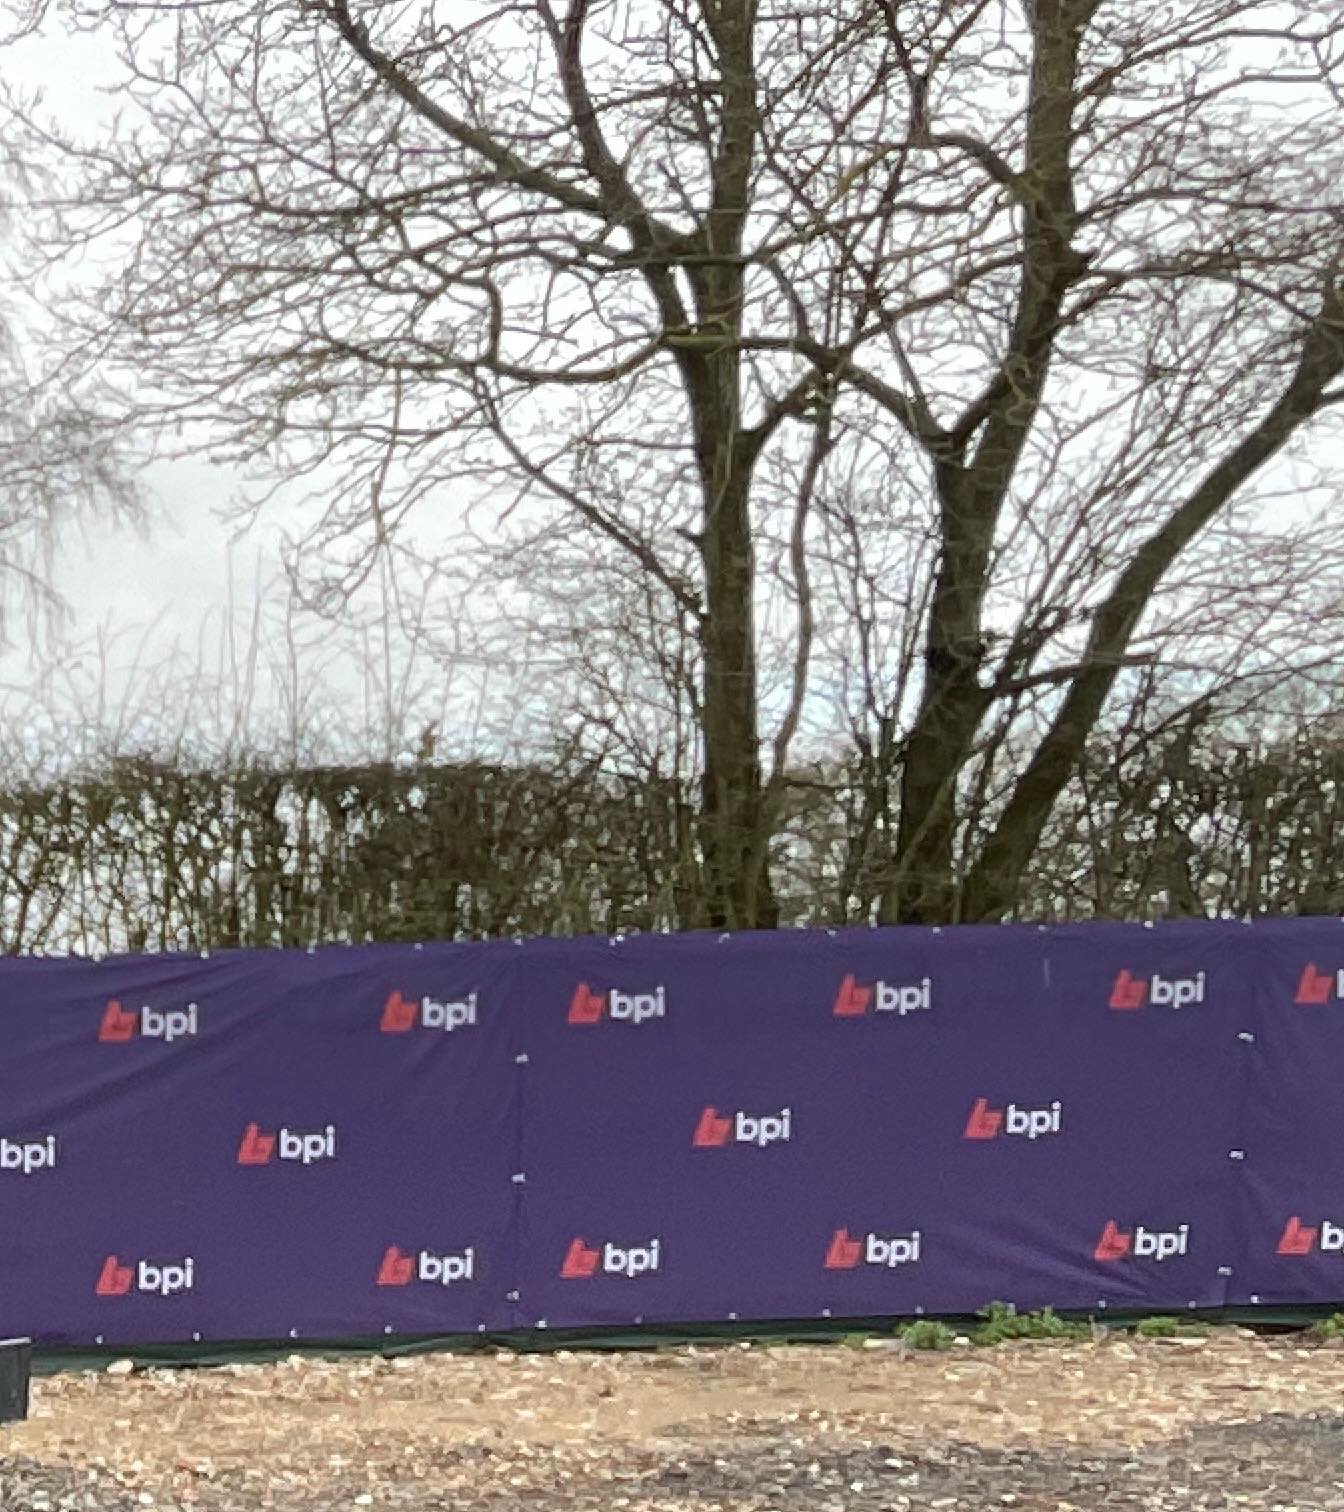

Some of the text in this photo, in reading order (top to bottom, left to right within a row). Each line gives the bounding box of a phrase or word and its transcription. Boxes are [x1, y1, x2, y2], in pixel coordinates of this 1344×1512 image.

[610, 985, 666, 1025] bpi
[876, 976, 932, 1016] bpi
[1149, 970, 1206, 1010] bpi
[141, 1002, 198, 1042] bpi
[422, 992, 478, 1032] bpi
[735, 1107, 792, 1148] bpi
[1006, 1100, 1062, 1140] bpi
[278, 1124, 336, 1164] bpi
[602, 1238, 662, 1278] bpi
[865, 1230, 921, 1268] bpi
[1134, 1224, 1190, 1262] bpi
[137, 1256, 194, 1296] bpi
[418, 1246, 474, 1286] bpi
